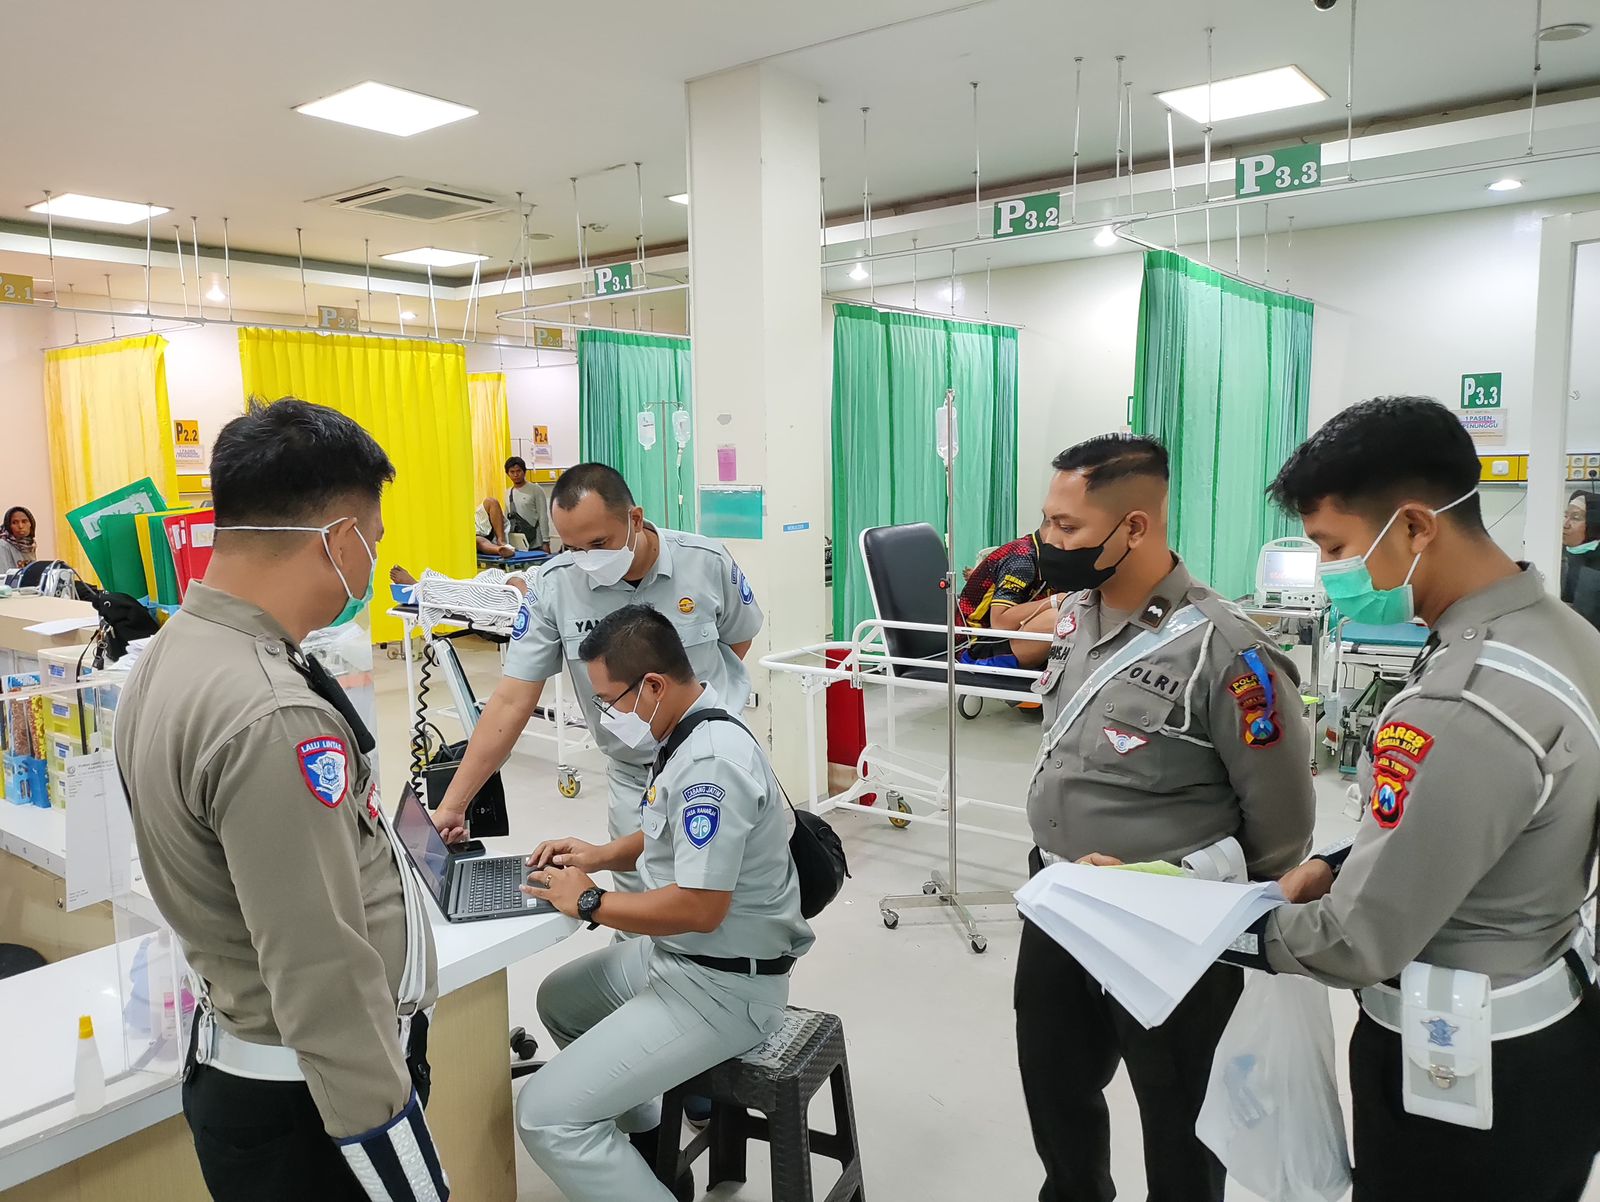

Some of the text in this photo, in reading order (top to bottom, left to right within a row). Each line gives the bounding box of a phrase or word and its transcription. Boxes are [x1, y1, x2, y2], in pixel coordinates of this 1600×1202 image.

[1239, 155, 1318, 195] P3.3
[997, 200, 1059, 234] P3.2
[596, 267, 631, 294] P3.1
[1464, 378, 1498, 405] P3.3
[176, 422, 198, 442] P2.2
[1129, 667, 1179, 694] OLRI
[301, 740, 343, 753] LALU LINTAS
[1377, 725, 1425, 748] POLRES
[686, 786, 706, 798] CABANG
